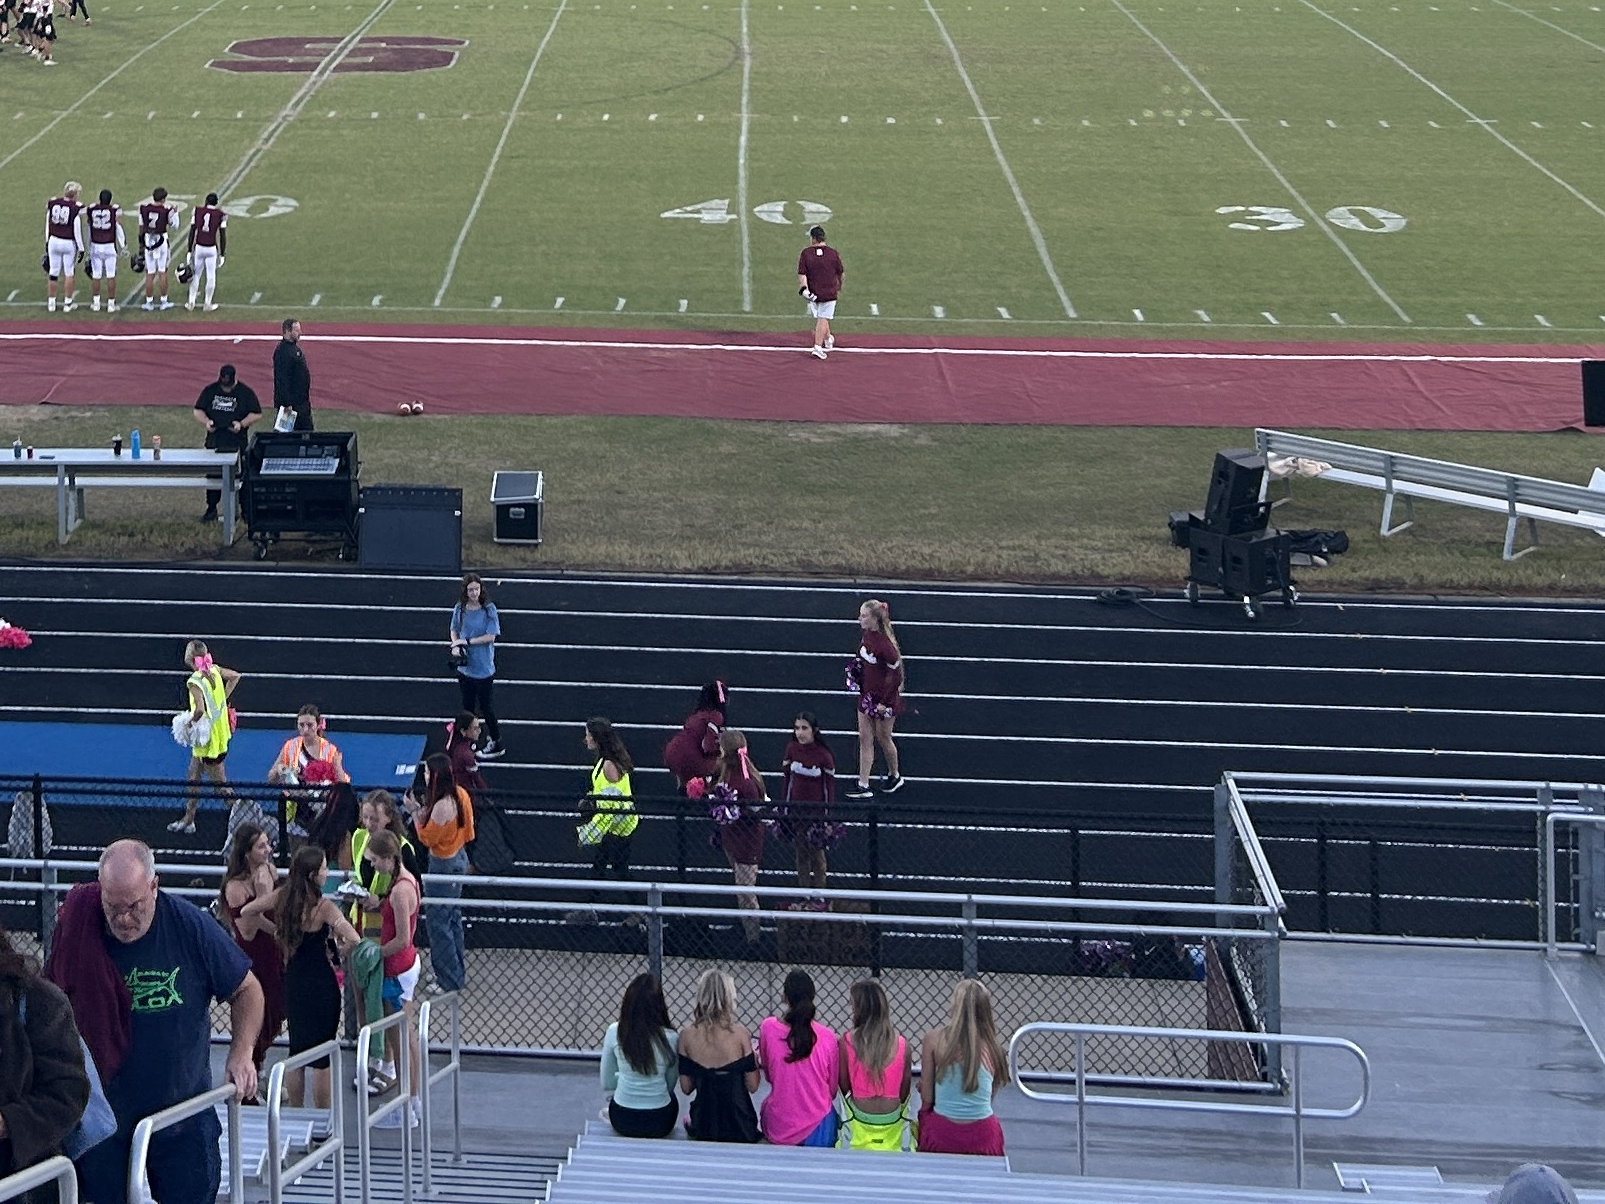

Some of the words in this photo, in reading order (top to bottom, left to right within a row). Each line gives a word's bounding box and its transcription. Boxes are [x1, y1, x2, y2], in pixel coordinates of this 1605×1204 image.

[148, 212, 160, 228] 7
[202, 212, 211, 232] 1
[660, 198, 834, 225] 40
[1214, 205, 1408, 233] 30
